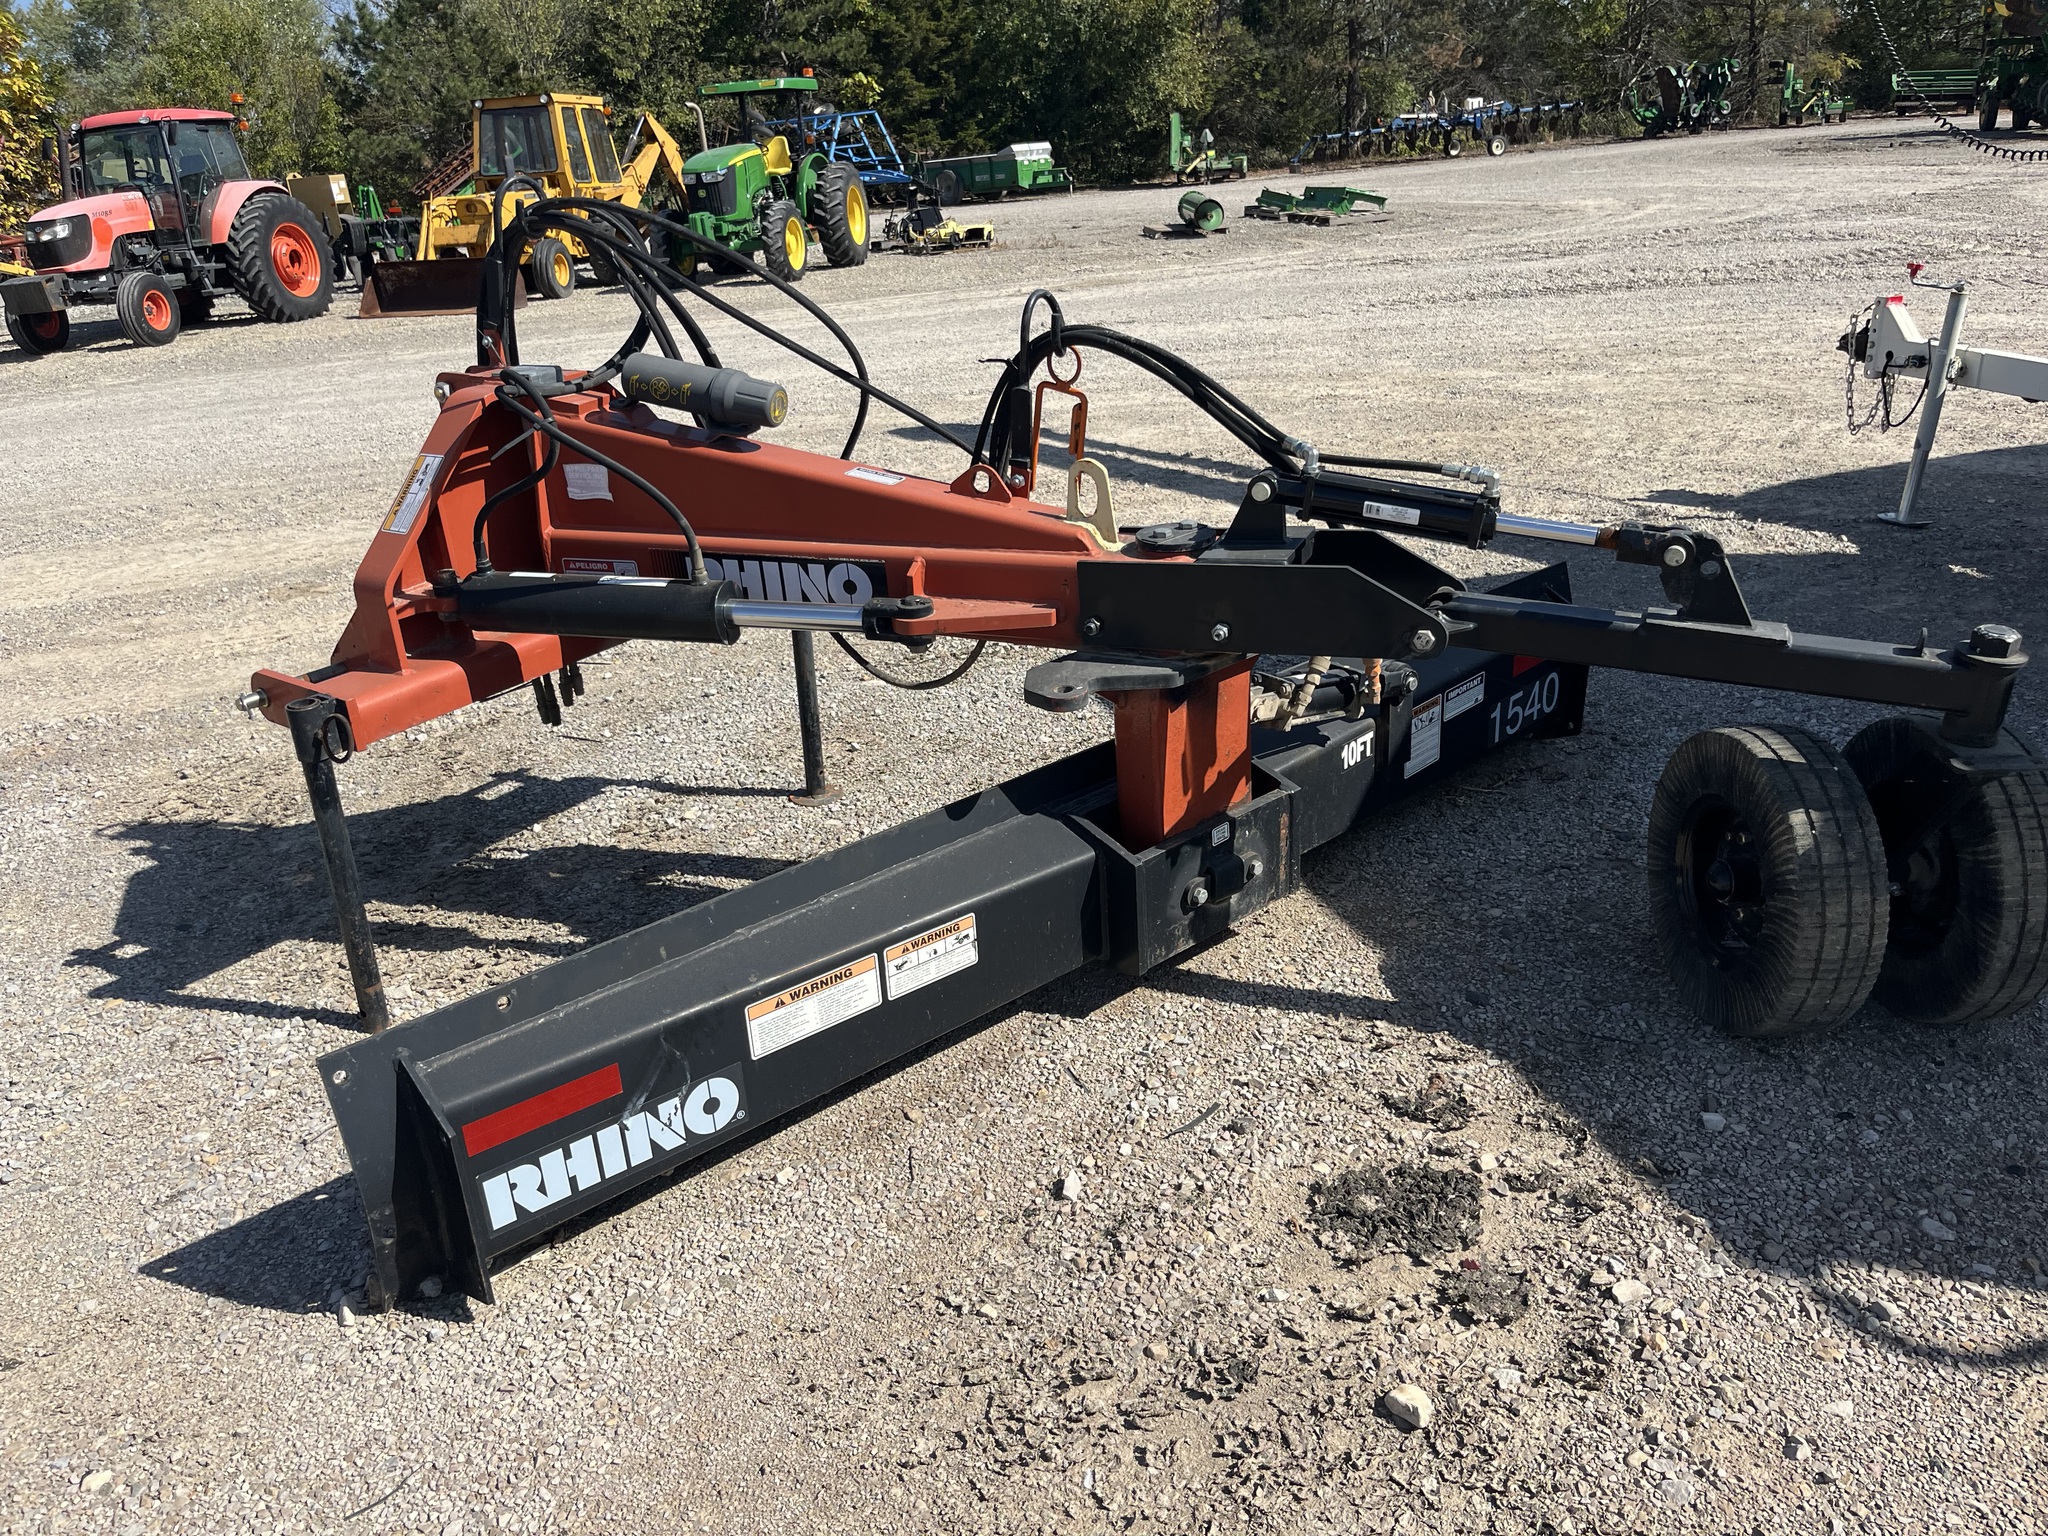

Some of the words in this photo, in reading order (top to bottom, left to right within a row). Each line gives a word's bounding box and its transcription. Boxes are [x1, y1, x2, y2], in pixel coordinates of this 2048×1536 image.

[397, 469, 419, 507] WARNING
[575, 562, 608, 571] PELIGRO
[1448, 676, 1482, 700] IMPORTANT
[1412, 699, 1440, 717] WARNING
[1490, 672, 1560, 743] 1540
[1341, 730, 1374, 770] 10FT
[911, 923, 960, 949] WARNING
[789, 968, 853, 1001] WARNING
[482, 1077, 740, 1231] RHINO
